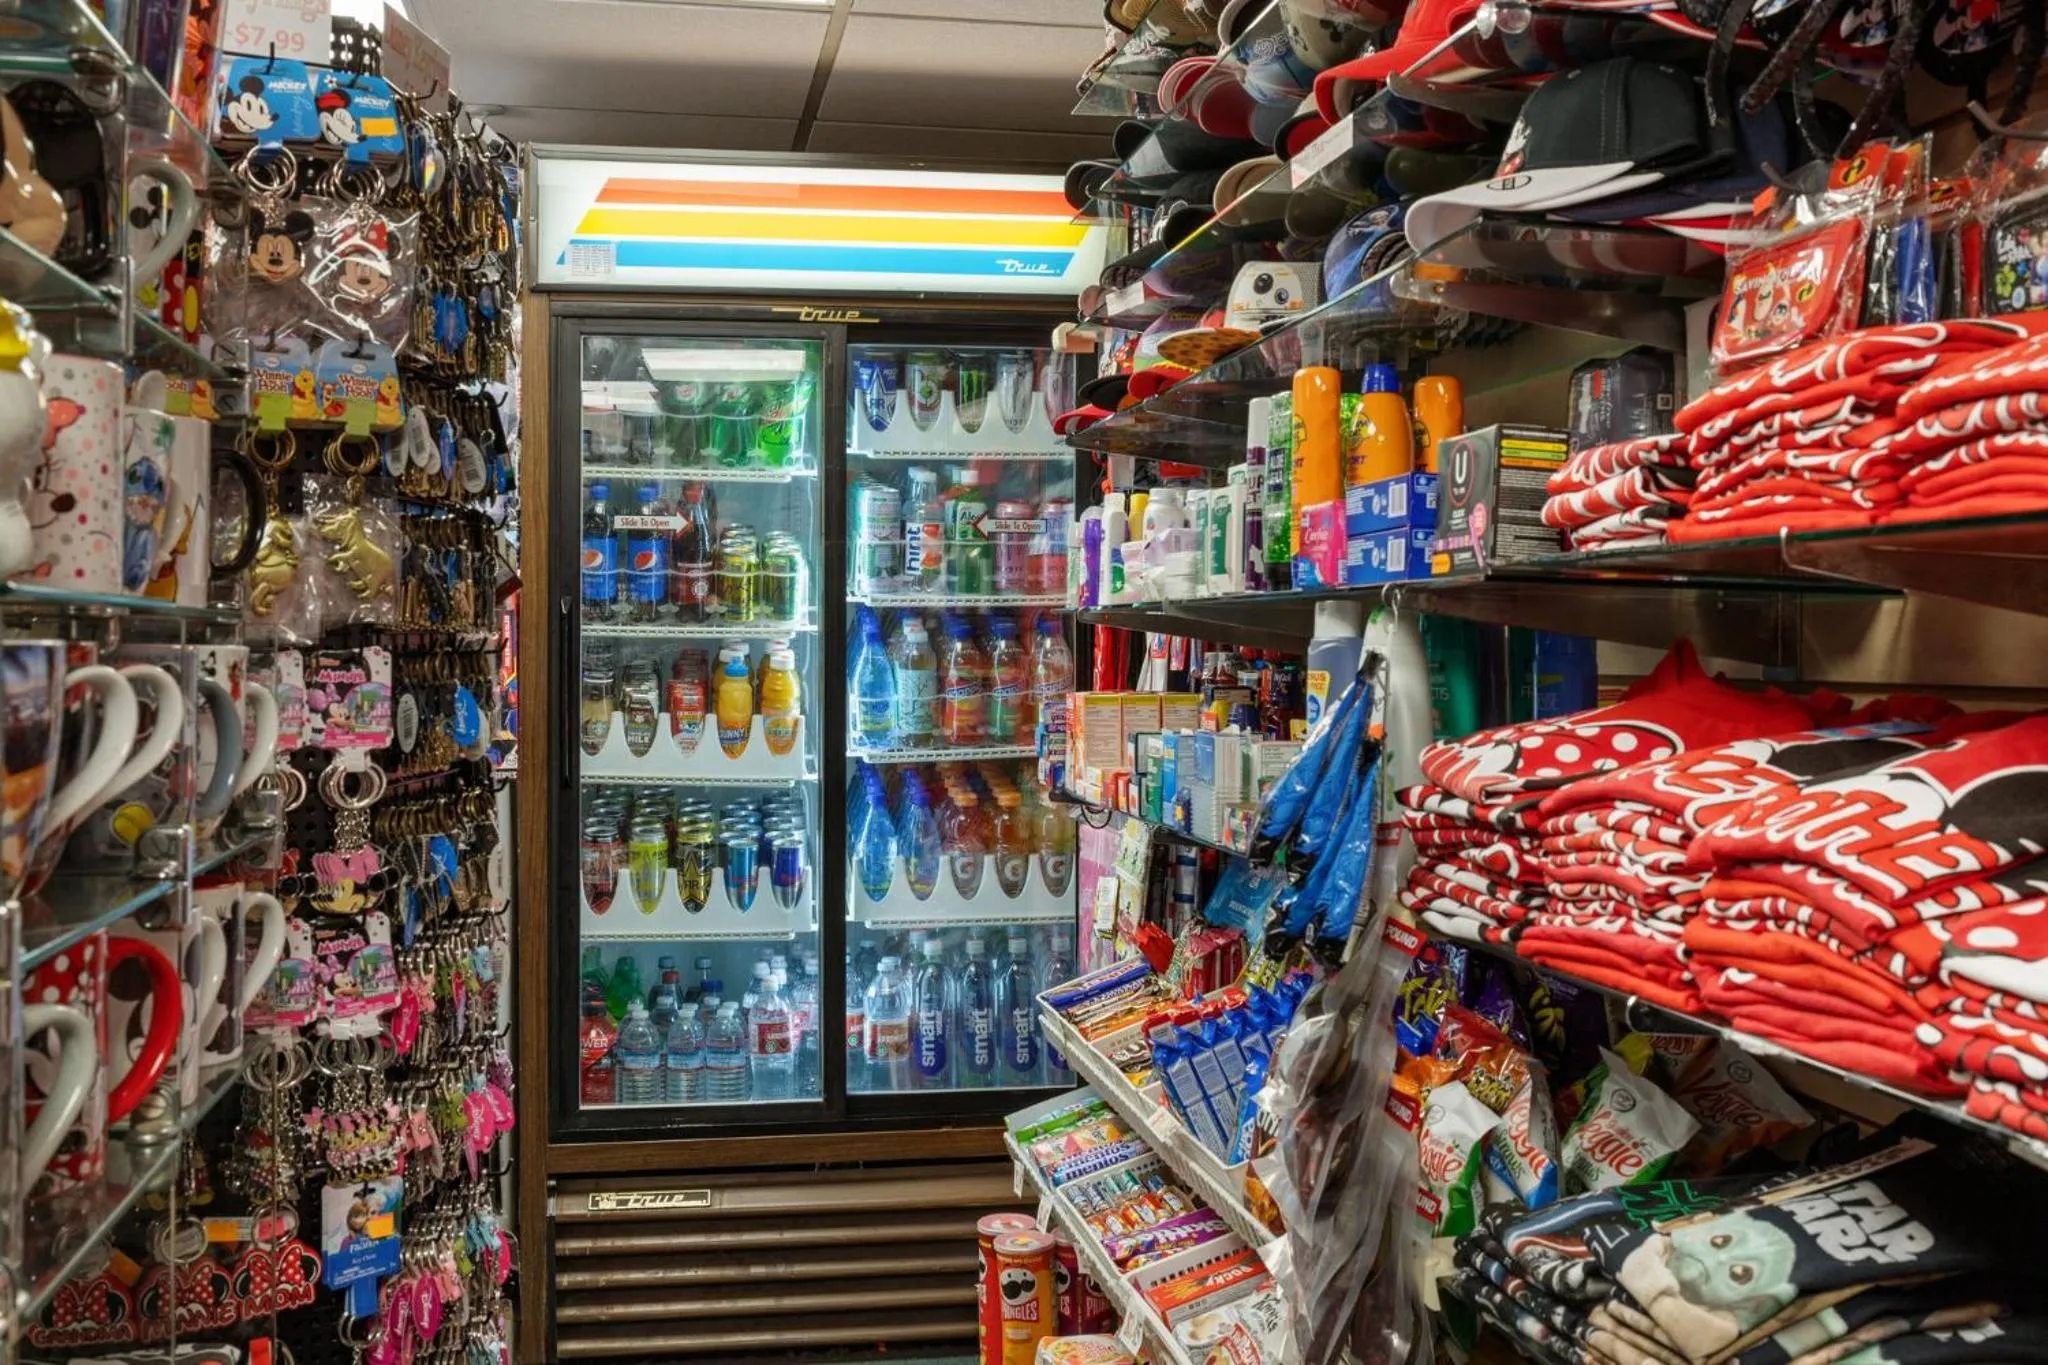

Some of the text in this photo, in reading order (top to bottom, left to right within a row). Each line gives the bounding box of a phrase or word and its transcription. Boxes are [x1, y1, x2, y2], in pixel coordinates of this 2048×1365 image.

[235, 24, 305, 50] $799
[166, 380, 187, 392] ooh
[620, 517, 670, 529] Slide To Open
[994, 521, 1012, 531] Slide
[1021, 522, 1041, 532] Open
[907, 525, 921, 572] hint
[584, 1039, 608, 1048] WER
[920, 1007, 936, 1067] smart
[972, 1008, 988, 1065] smart
[1013, 1008, 1029, 1064] smart
[1064, 1152, 1130, 1181] mentos
[1417, 1194, 1437, 1213] UND
[242, 1283, 316, 1319] MOM
